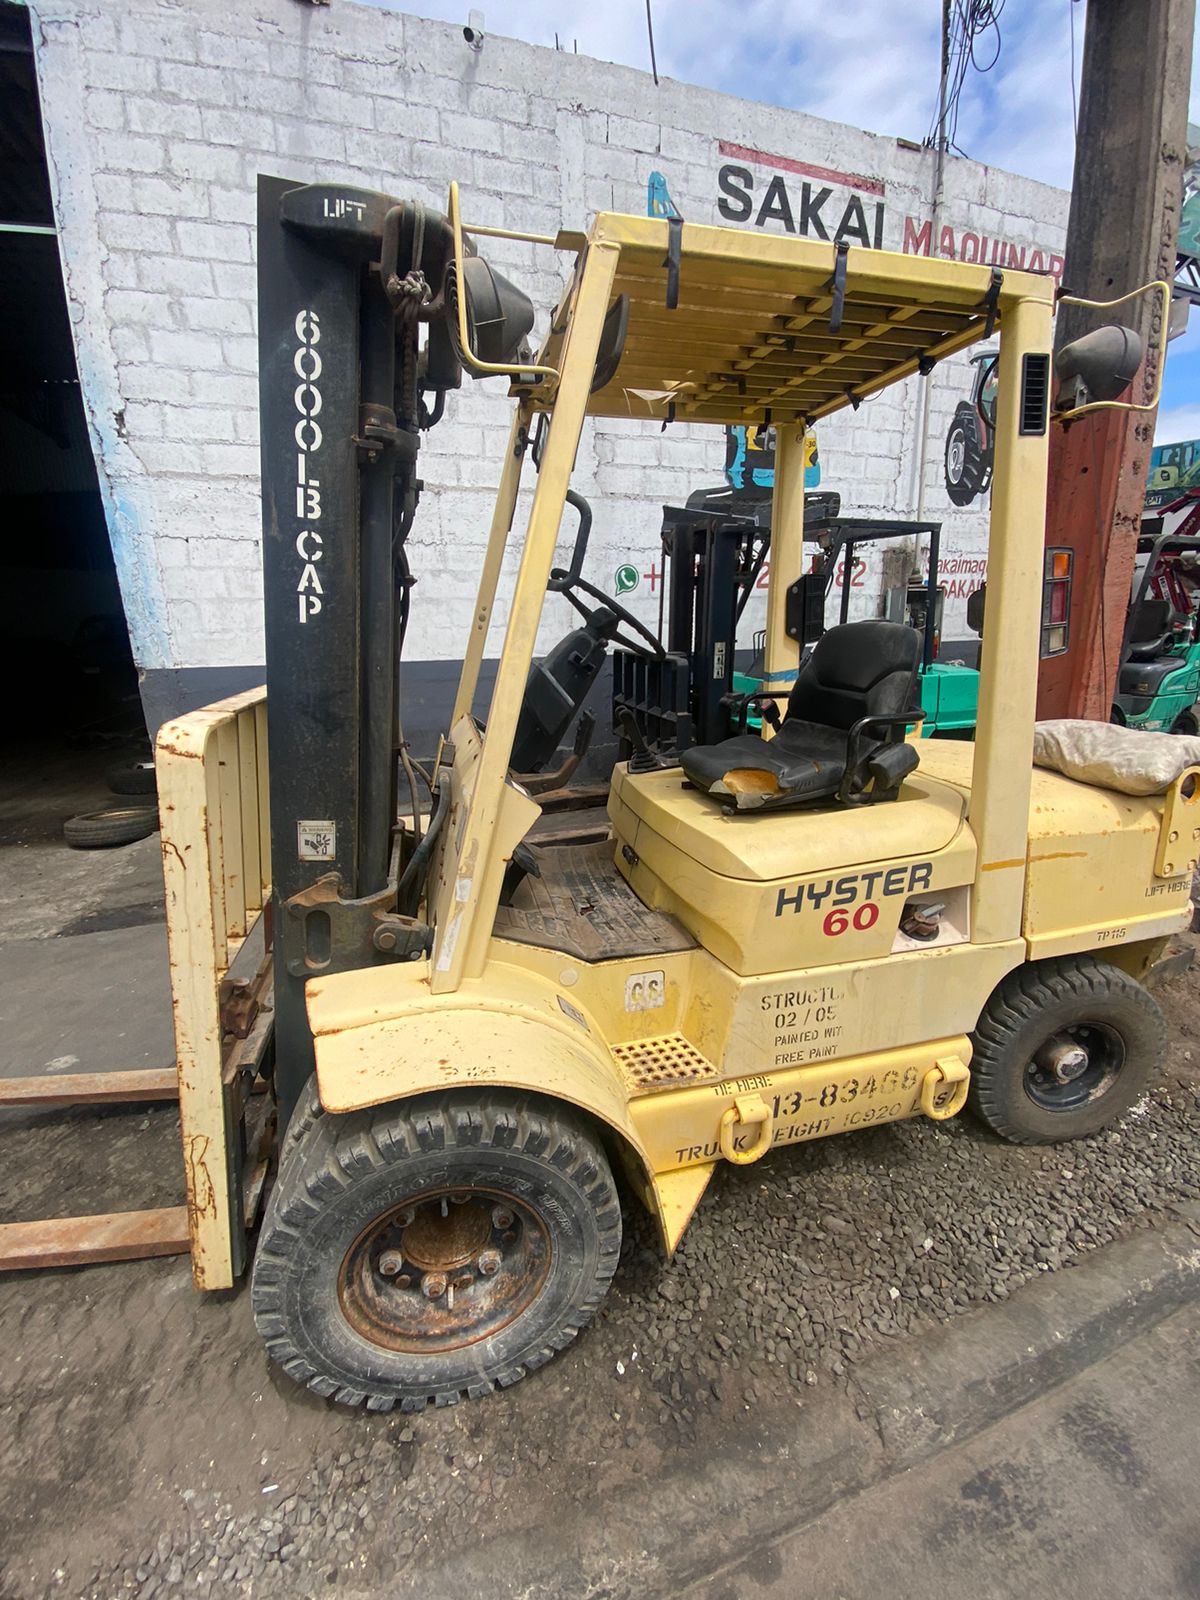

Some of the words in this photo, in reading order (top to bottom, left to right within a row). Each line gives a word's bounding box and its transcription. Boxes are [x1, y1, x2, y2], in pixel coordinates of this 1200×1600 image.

[323, 198, 367, 222] LIFT
[717, 163, 884, 251] SAKAI
[295, 530, 324, 624] CAP
[775, 862, 933, 917] HYSTER
[1144, 884, 1165, 898] LIFT
[1167, 880, 1192, 894] HERE
[822, 902, 880, 937] 60
[774, 1011, 797, 1029] 02
[774, 1030, 819, 1047] PAINTED
[774, 1050, 804, 1065] FREE
[809, 1044, 839, 1059] PAINT
[710, 1082, 733, 1096] TIE
[735, 1075, 774, 1093] HERE
[675, 1135, 748, 1164] TRUK
[759, 1115, 835, 1143] EIGHT
[910, 1091, 948, 1113] LS
